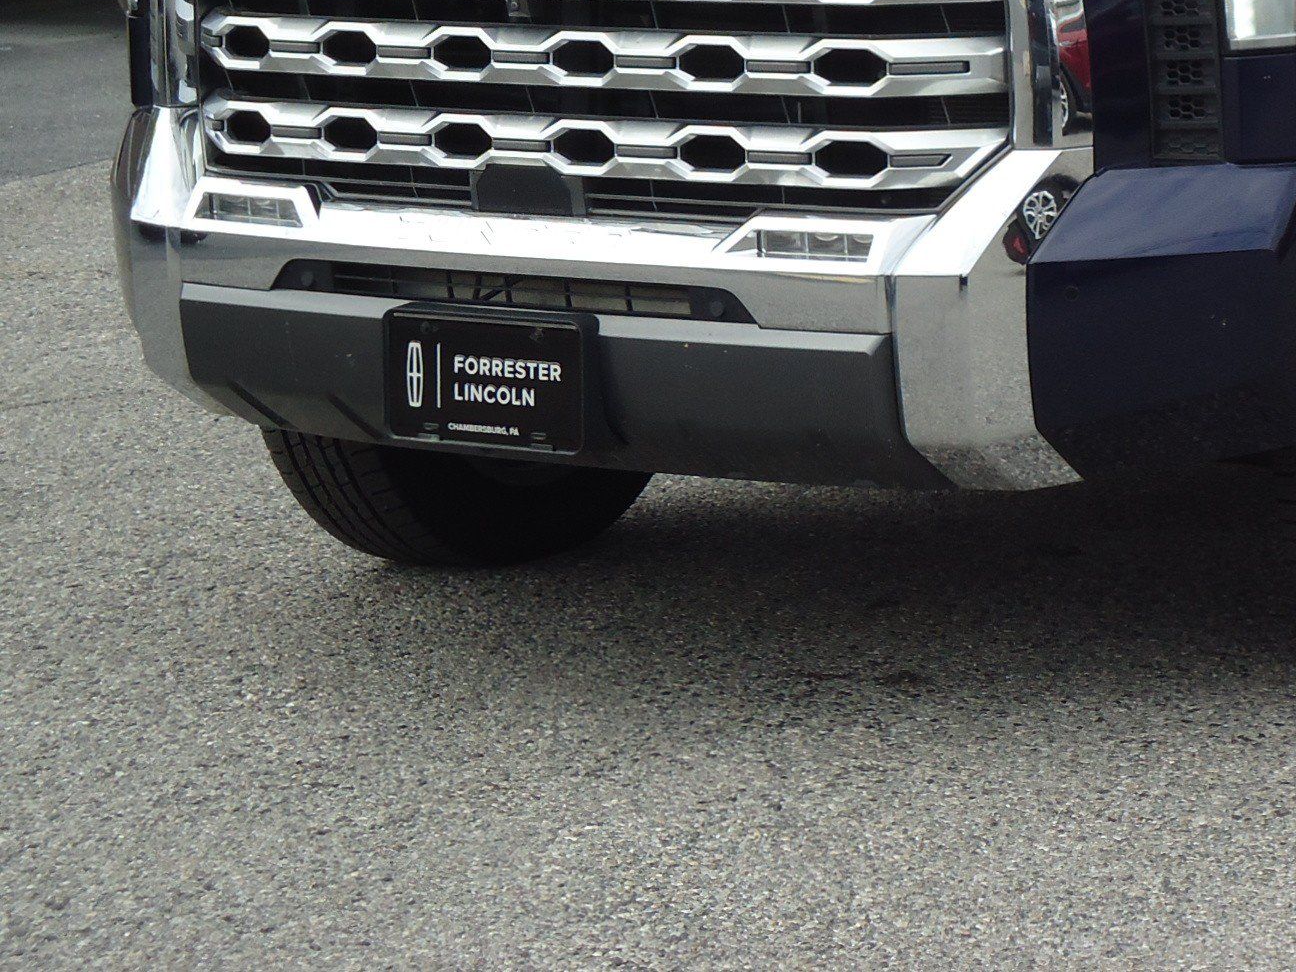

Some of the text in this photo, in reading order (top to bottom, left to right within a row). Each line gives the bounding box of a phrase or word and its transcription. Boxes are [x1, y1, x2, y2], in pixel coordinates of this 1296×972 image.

[453, 354, 562, 382] FORRESTER
[453, 382, 536, 407] LINCOLN
[447, 422, 520, 436] CHAMBERSBURG, PA
